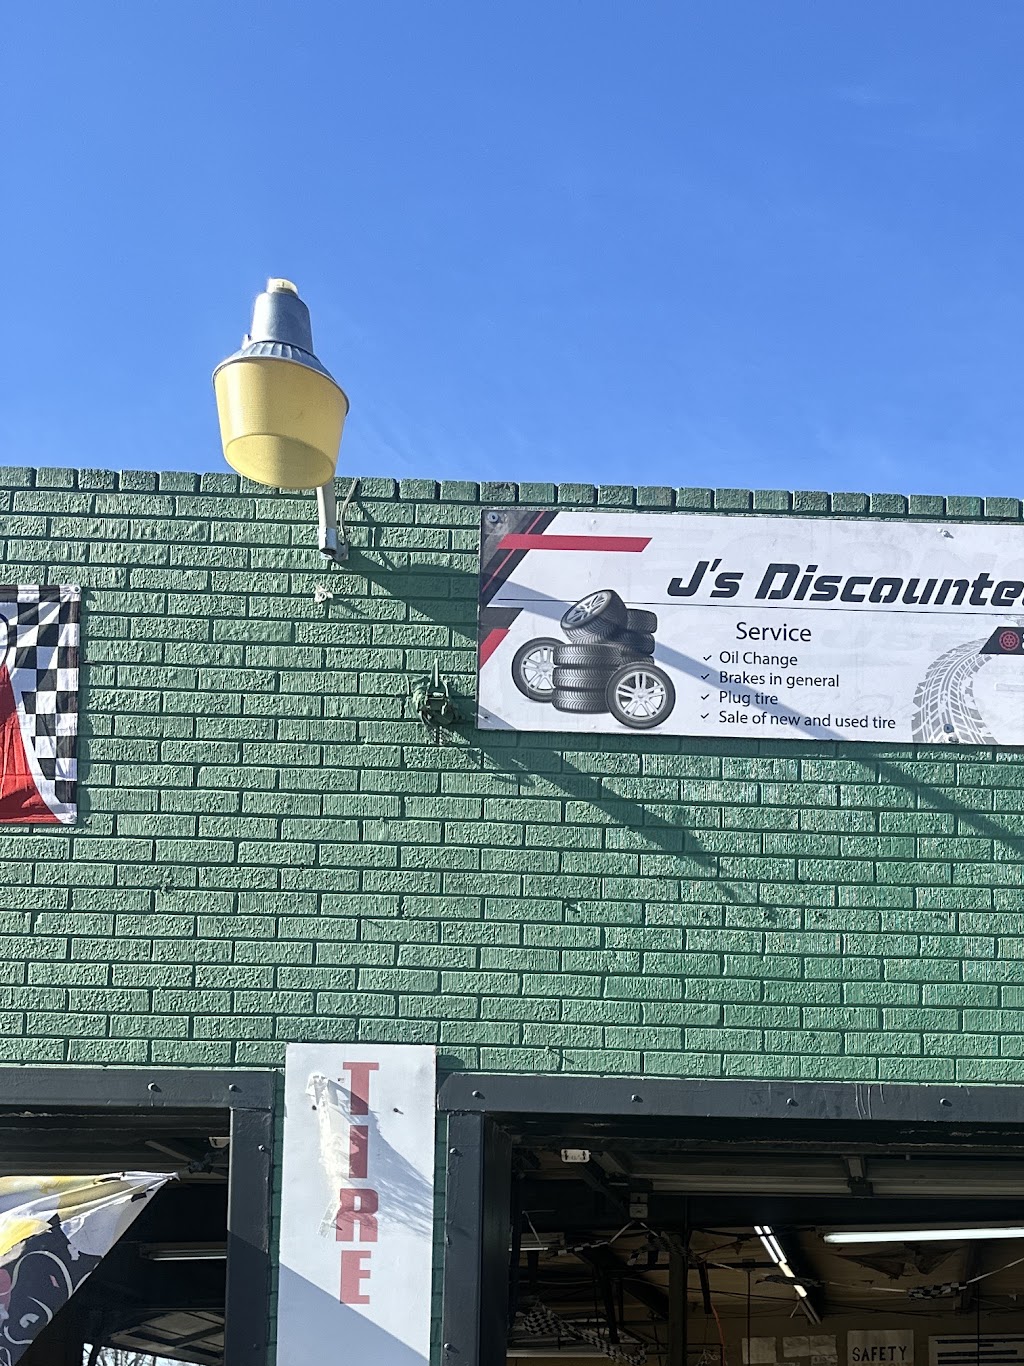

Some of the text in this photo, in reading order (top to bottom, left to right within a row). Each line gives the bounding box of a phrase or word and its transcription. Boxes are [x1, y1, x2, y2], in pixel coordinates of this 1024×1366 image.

[667, 558, 744, 598] J's
[736, 621, 812, 642] Service
[719, 651, 798, 668] Oil Change
[719, 671, 839, 689] Brakes in general
[719, 691, 778, 707] Plug tire
[719, 711, 896, 729] Sale of new and used tire
[336, 1062, 379, 1304] TIRE
[852, 1345, 907, 1361] SAFETY
